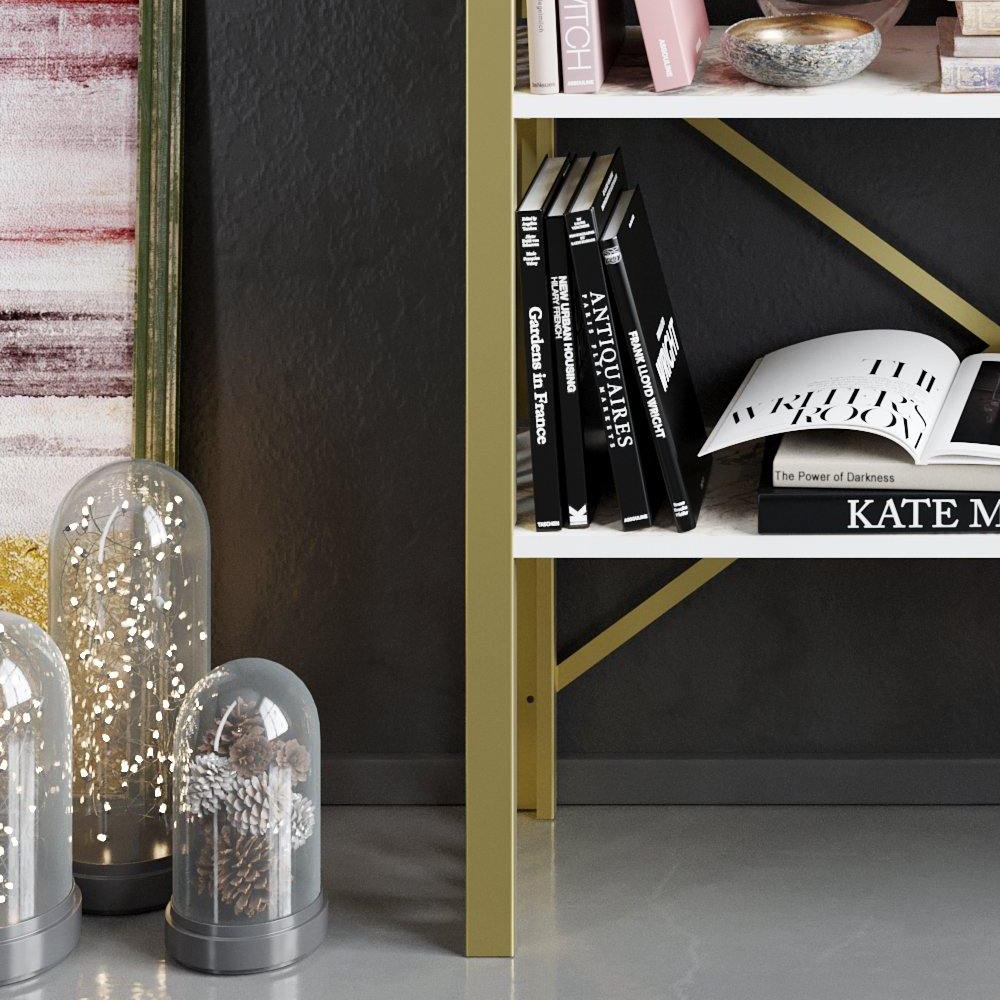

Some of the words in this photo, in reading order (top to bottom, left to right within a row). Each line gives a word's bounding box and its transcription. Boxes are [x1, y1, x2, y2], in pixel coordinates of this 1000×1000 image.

[550, 276, 560, 305] HILARY
[558, 275, 569, 301] NEW
[528, 306, 545, 371] Gardens
[552, 306, 563, 340] FRENCH
[560, 302, 572, 341] URBAN
[532, 373, 547, 389] in
[563, 343, 577, 394] HOUSING
[589, 291, 634, 448] ANTIQUAIRES
[628, 330, 645, 367] FRANK
[637, 364, 654, 398] LLOYD
[646, 396, 666, 439] WRIGHT
[533, 391, 548, 445] France
[775, 470, 794, 482] The
[798, 472, 828, 483] Power
[832, 472, 844, 483] of
[847, 472, 895, 483] Darkness
[847, 498, 959, 529] KATE
